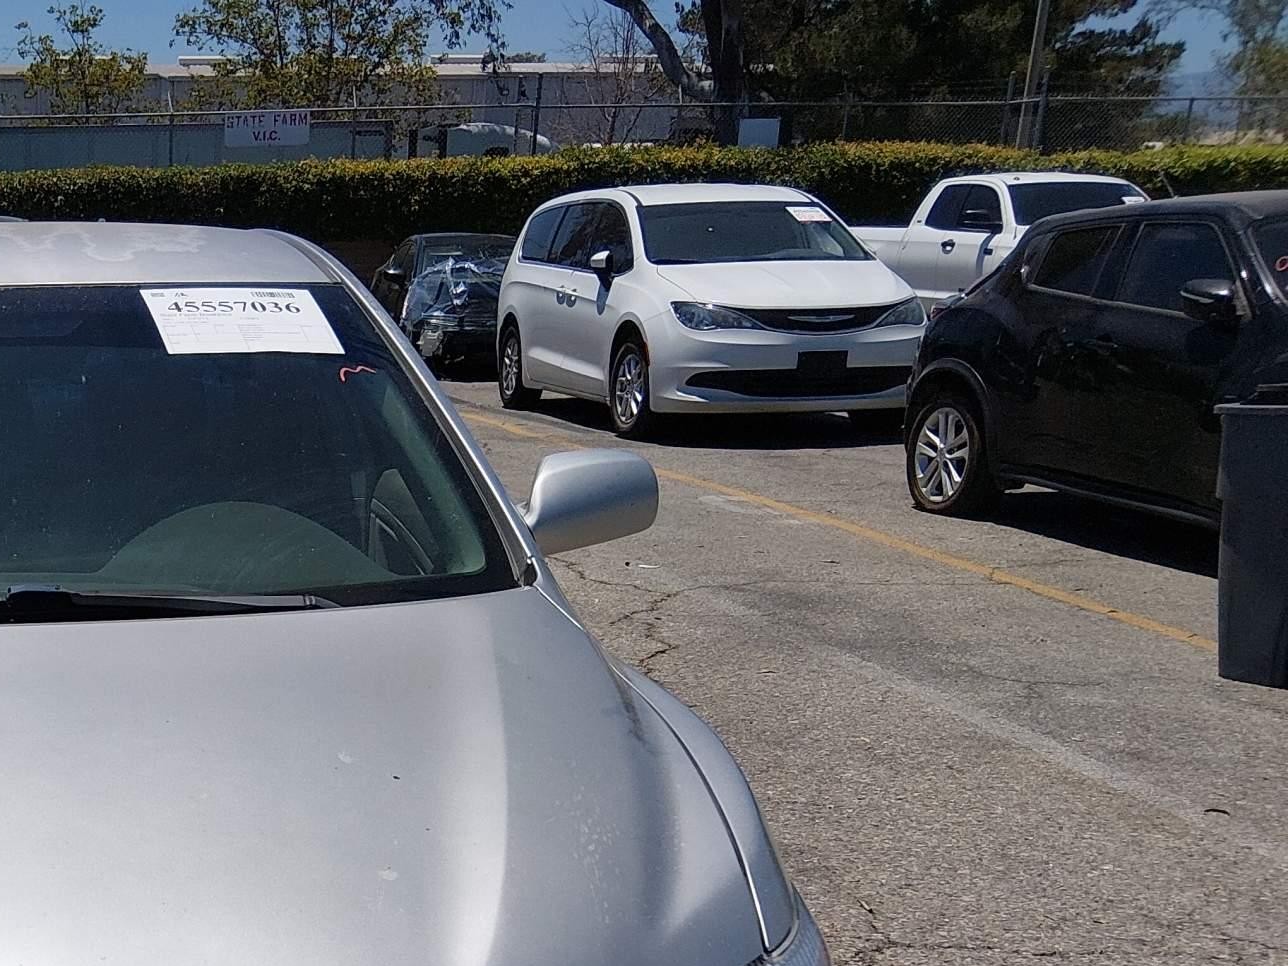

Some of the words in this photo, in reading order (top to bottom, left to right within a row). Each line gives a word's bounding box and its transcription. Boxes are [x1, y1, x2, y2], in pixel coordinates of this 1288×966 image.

[226, 115, 265, 129] STATE
[273, 112, 308, 127] FARM
[252, 130, 281, 142] V.I.C.
[167, 301, 301, 314] 45557036
